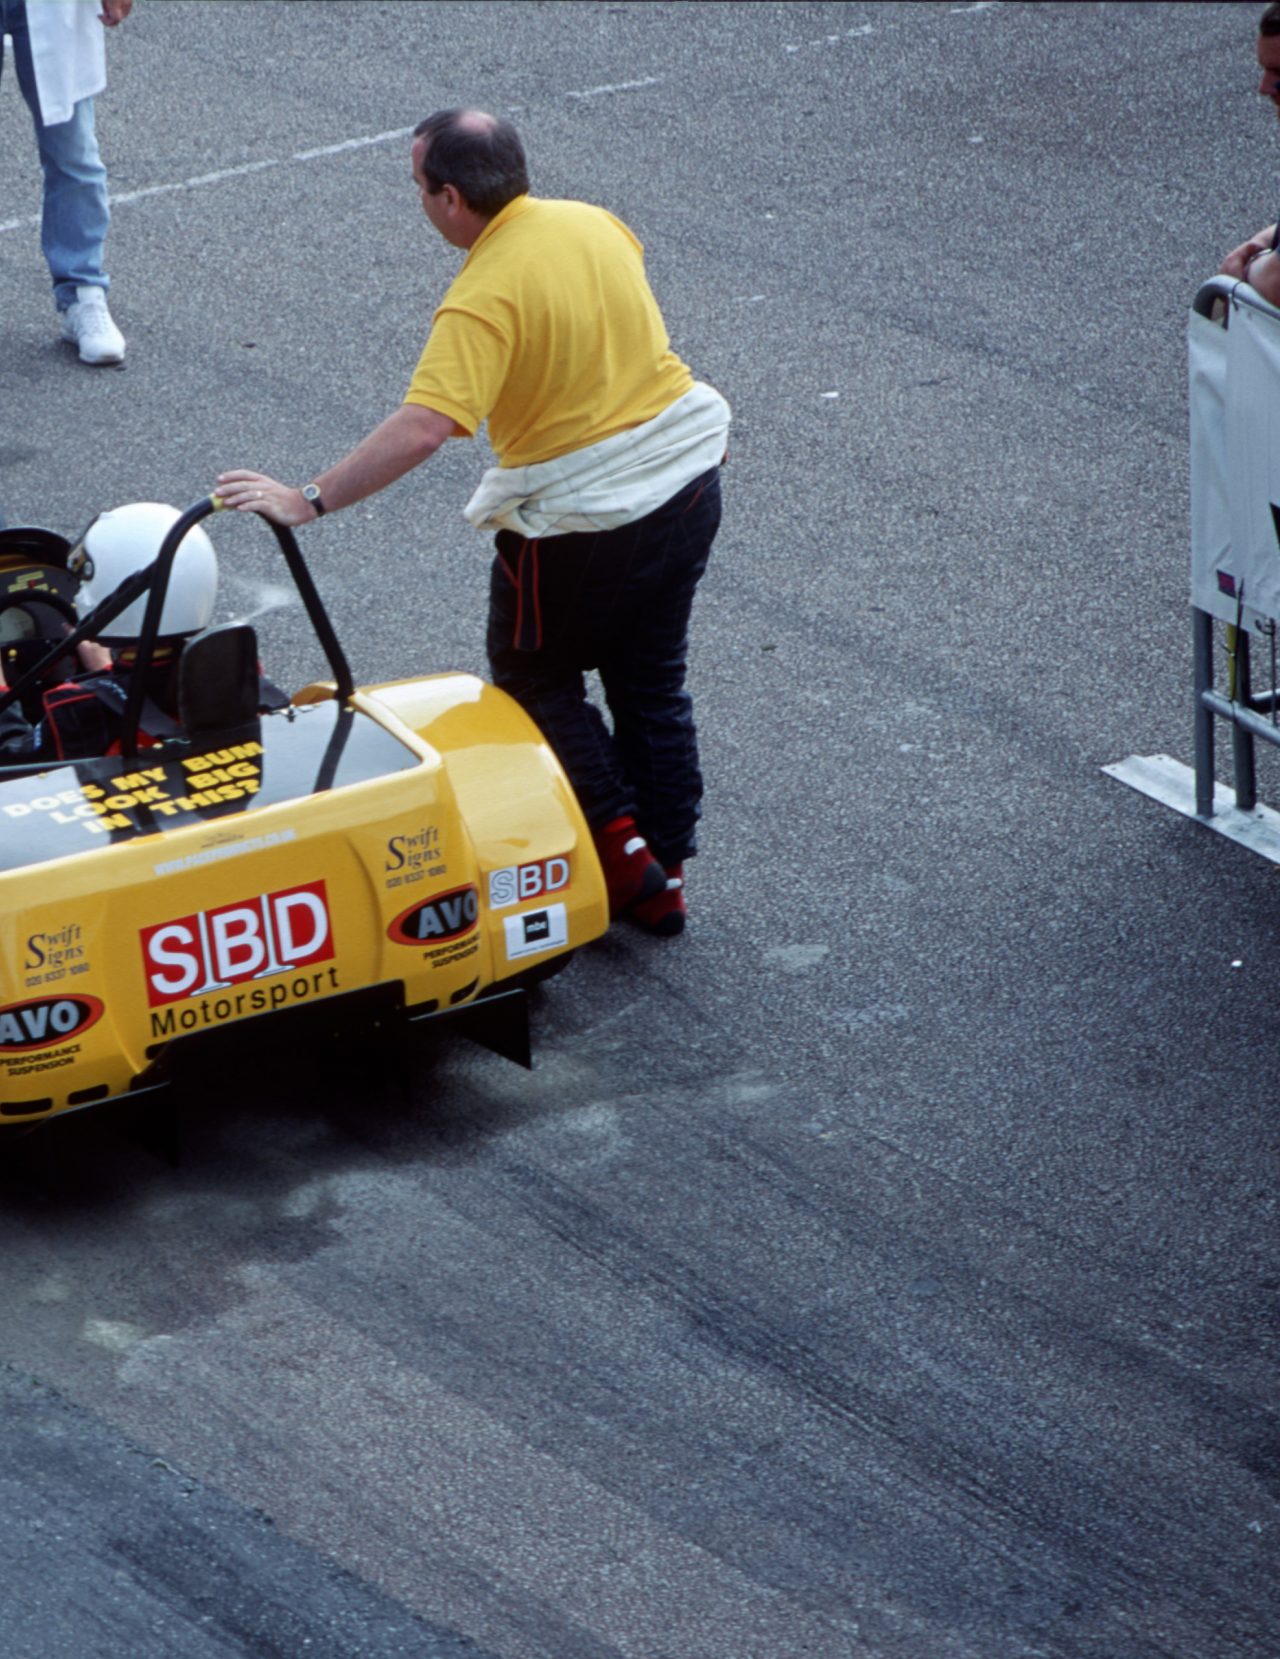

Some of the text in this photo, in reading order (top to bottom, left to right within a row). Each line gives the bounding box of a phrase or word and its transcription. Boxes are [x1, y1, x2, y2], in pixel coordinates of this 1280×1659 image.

[1, 741, 264, 818] DOES MY BUM
[49, 762, 261, 824] LOOK BIG
[82, 779, 261, 834] IN THIS?
[385, 826, 439, 871] Swift
[490, 858, 569, 905] SBD
[417, 890, 478, 939] AVO
[24, 923, 82, 970] Swift
[148, 892, 328, 995] SBD
[150, 967, 340, 1038] Motorsport
[8, 1056, 75, 1076] SUSPENSION
